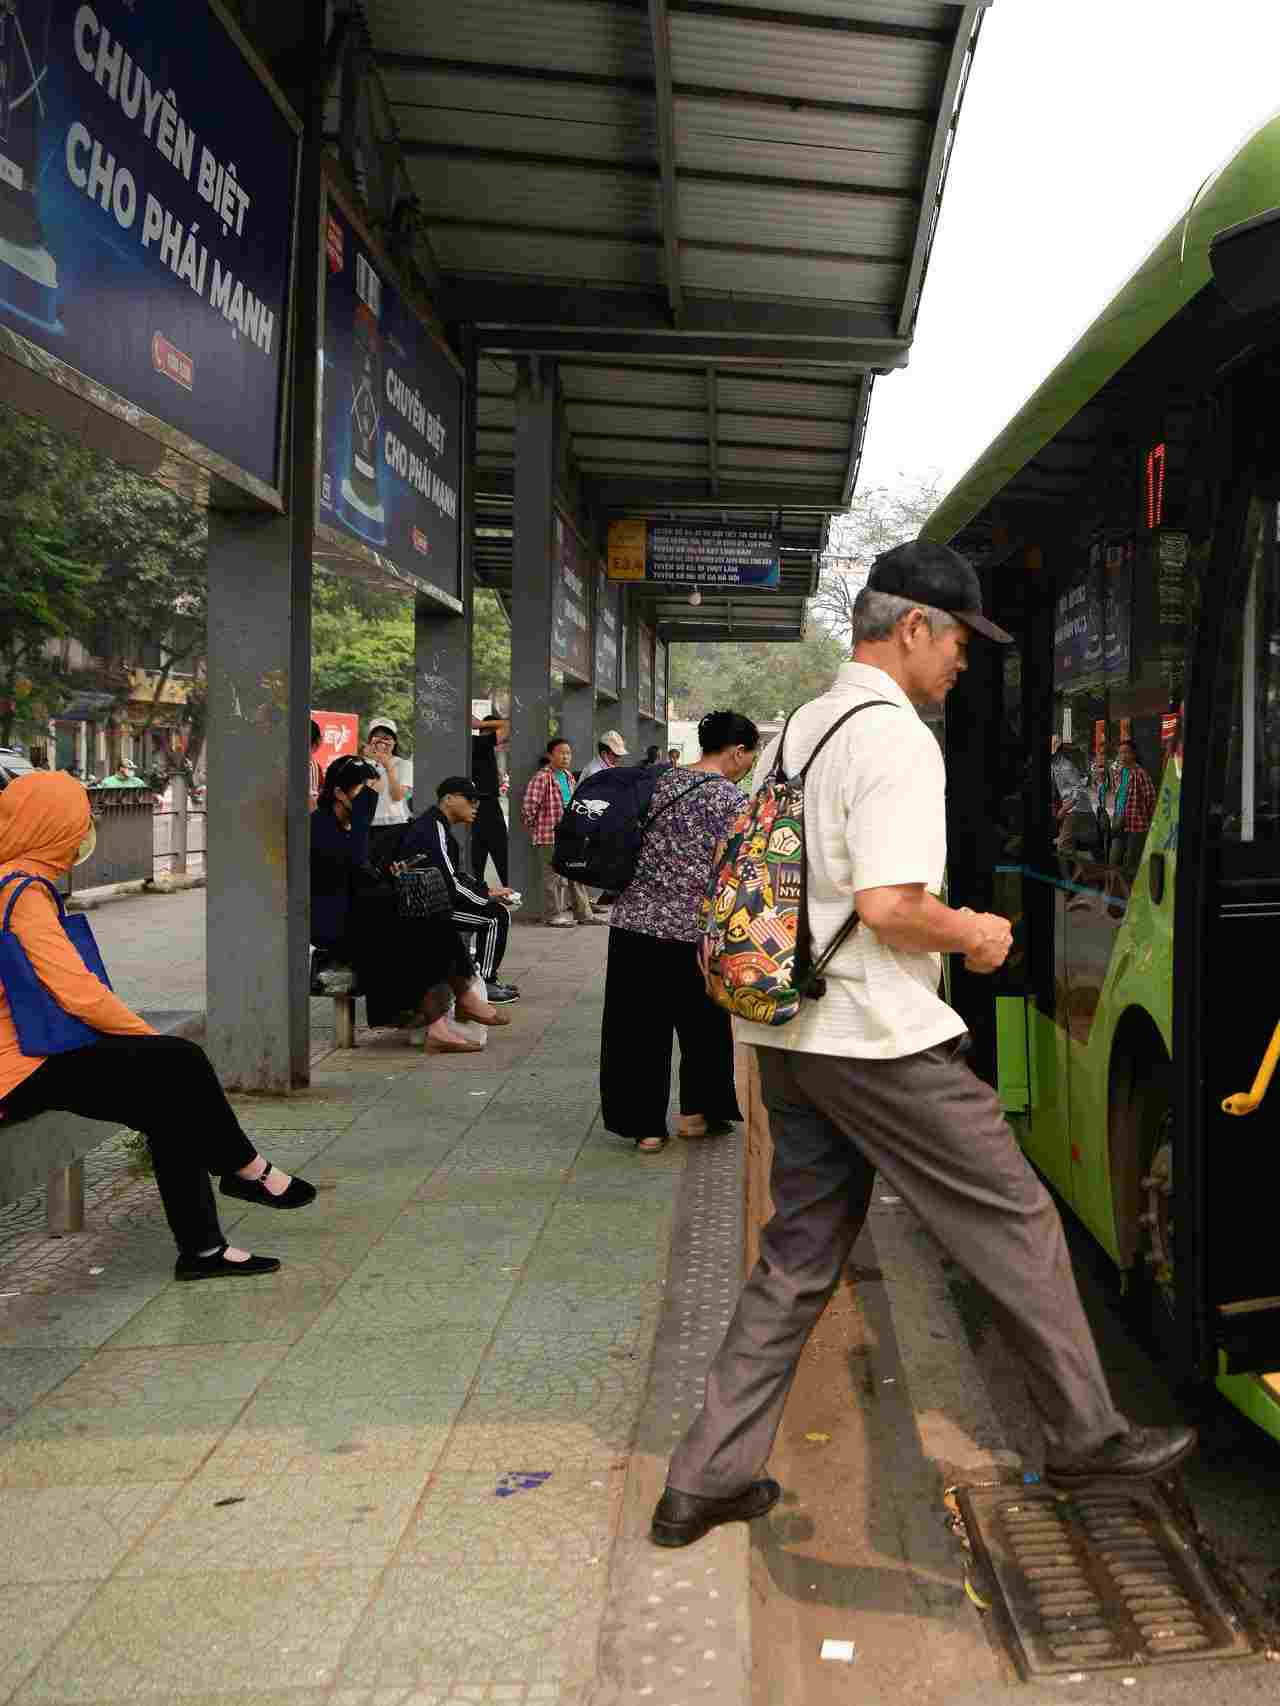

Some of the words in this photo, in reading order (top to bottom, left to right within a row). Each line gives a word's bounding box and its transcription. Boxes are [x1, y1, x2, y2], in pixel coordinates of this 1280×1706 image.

[73, 4, 196, 181] CHUYÊN
[197, 146, 251, 237] BIỆT
[66, 121, 137, 230] CHO
[141, 192, 208, 297] PHÁI
[210, 258, 274, 355] MẠNH
[384, 431, 408, 478] CHO
